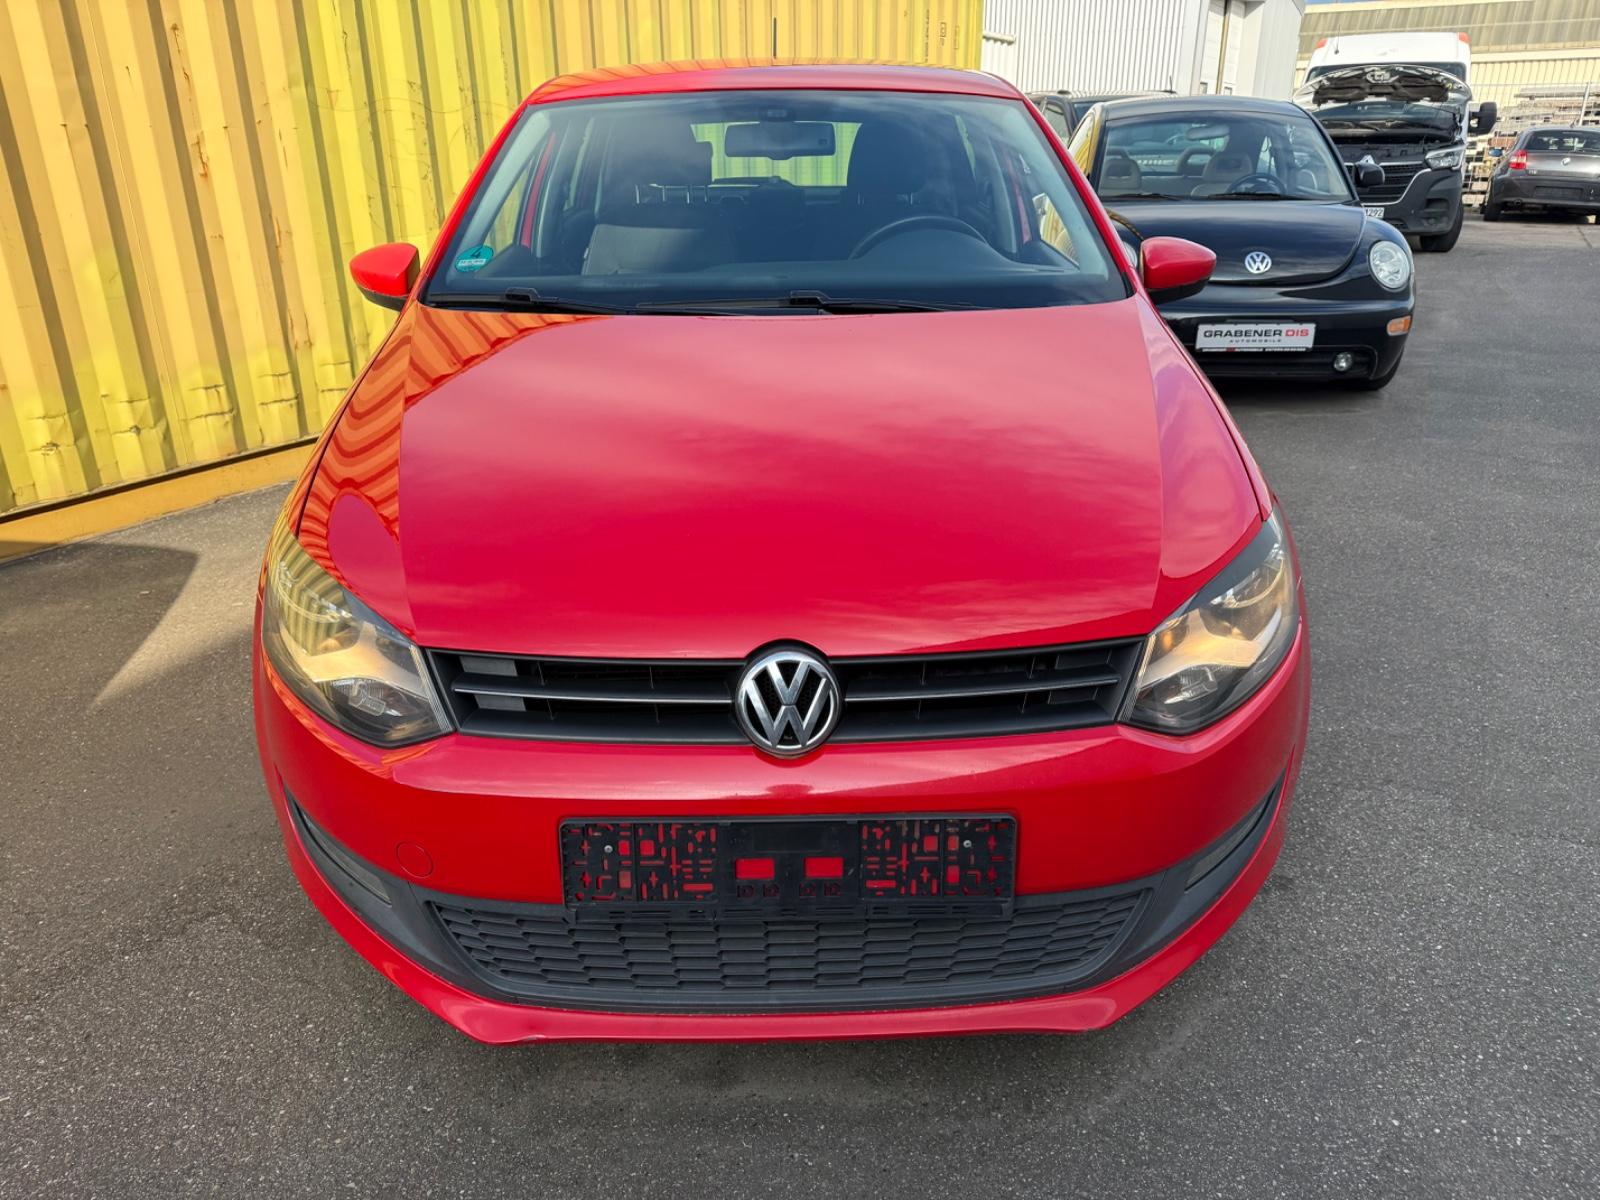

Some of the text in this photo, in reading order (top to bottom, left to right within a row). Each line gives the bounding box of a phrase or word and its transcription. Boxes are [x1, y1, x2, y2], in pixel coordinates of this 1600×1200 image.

[471, 246, 483, 258] 4
[1246, 252, 1271, 273] VW
[1204, 328, 1309, 338] GRABENER DIS
[740, 654, 836, 751] VW
